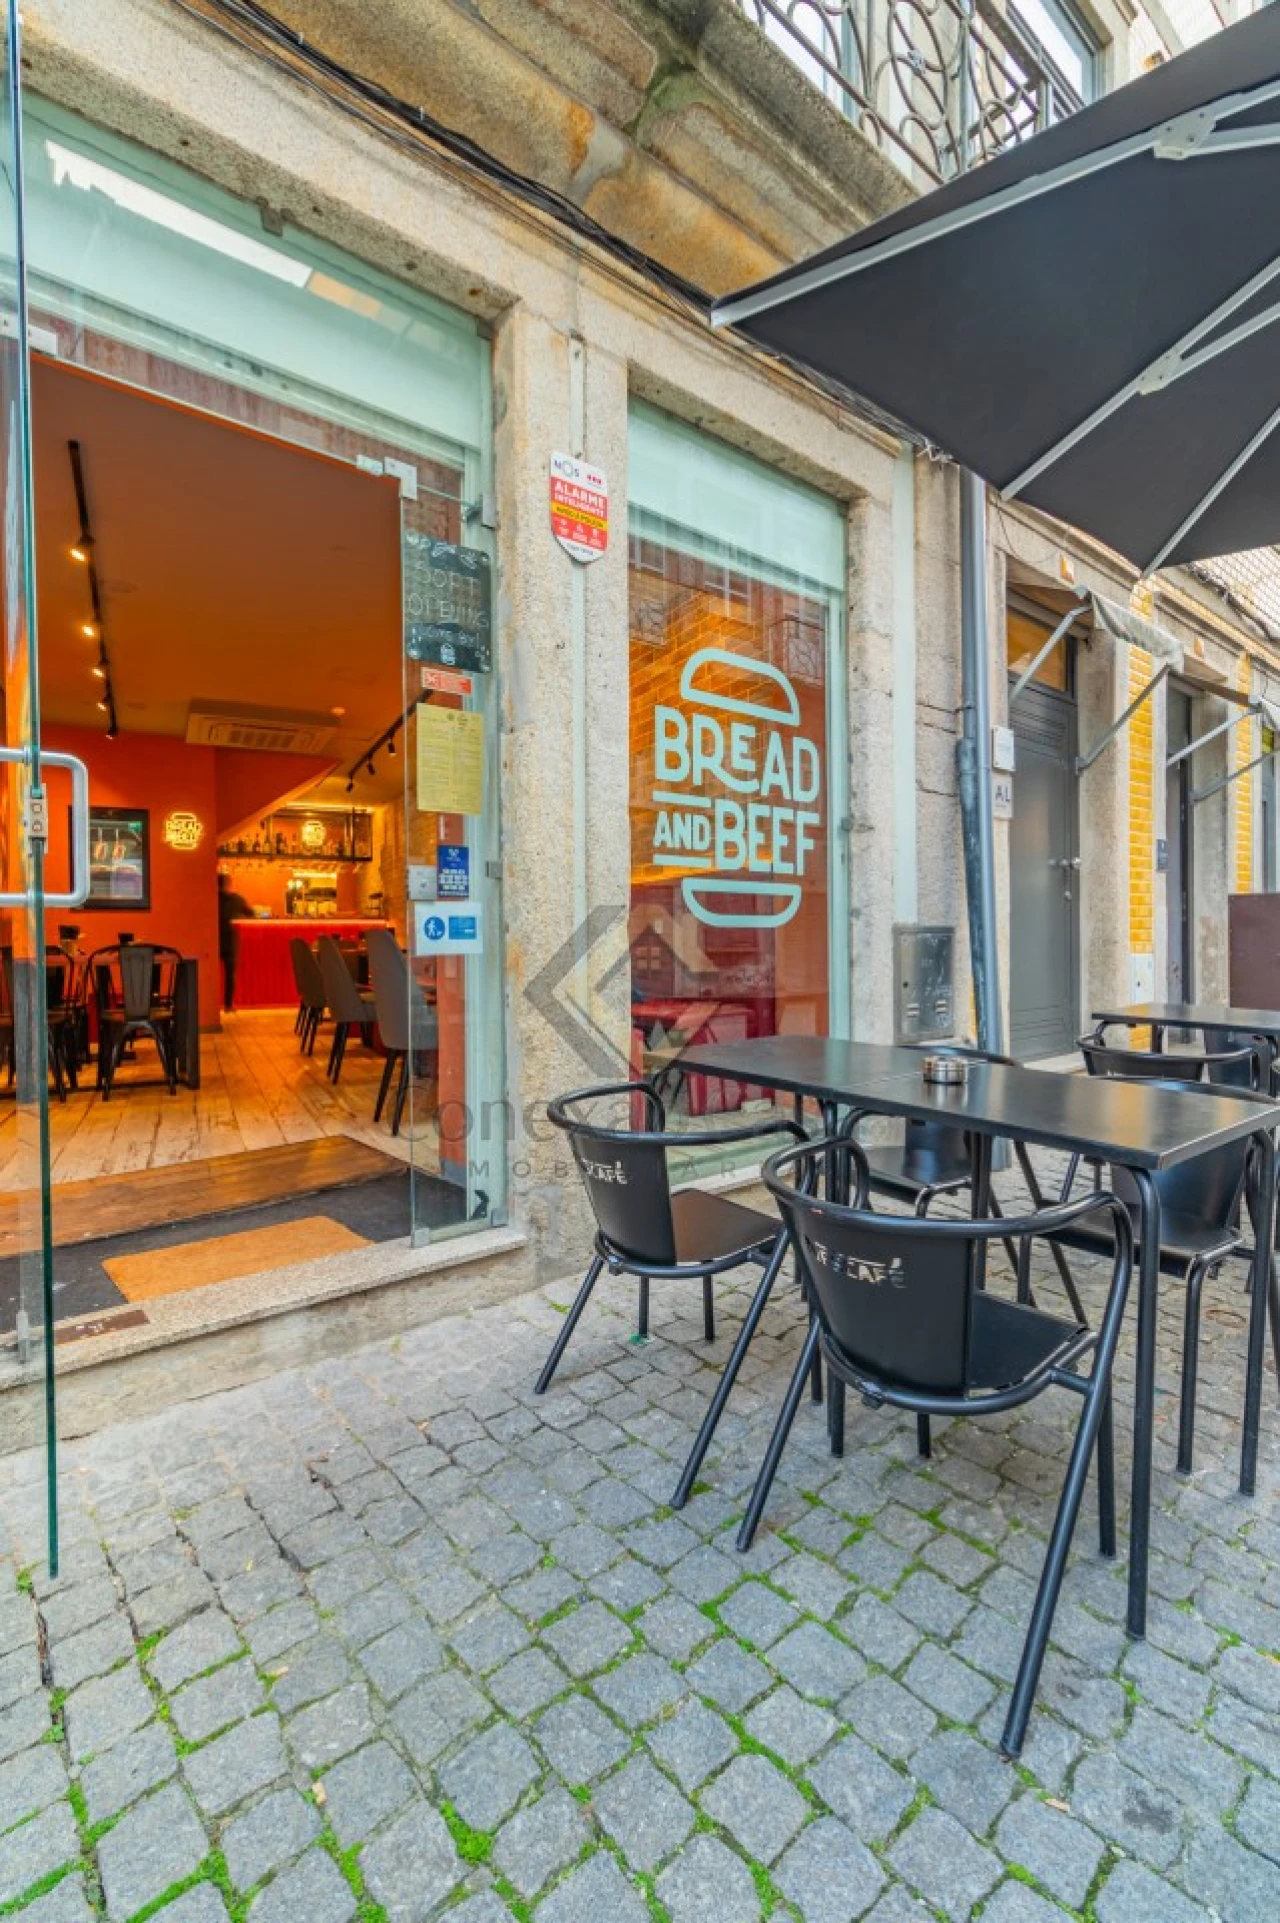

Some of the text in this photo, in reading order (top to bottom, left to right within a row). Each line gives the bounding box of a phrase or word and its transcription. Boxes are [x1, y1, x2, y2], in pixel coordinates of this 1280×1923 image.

[654, 704, 820, 803] BREAD
[653, 798, 820, 876] AND BEEF
